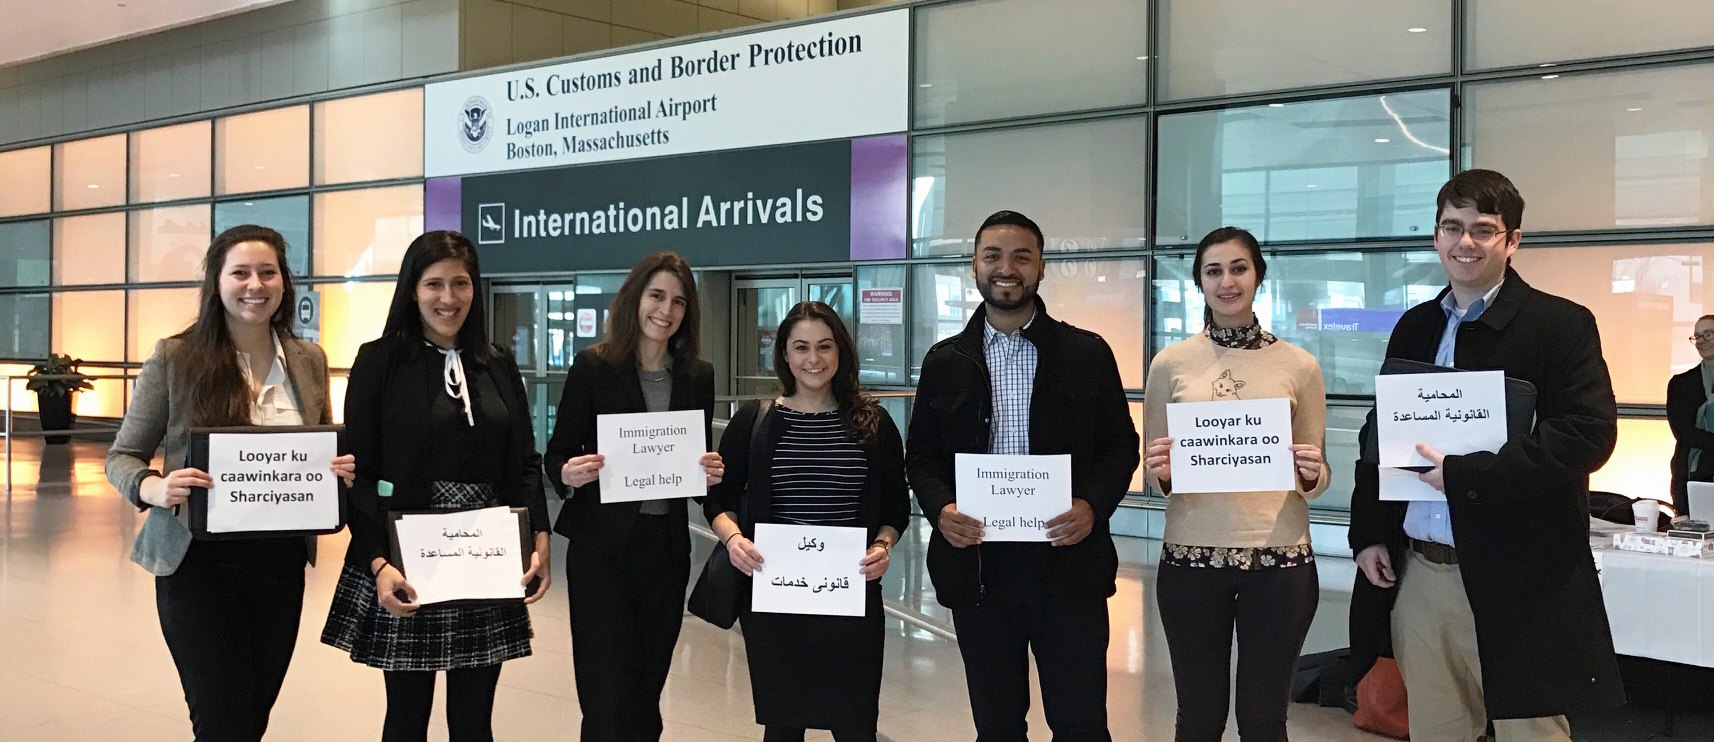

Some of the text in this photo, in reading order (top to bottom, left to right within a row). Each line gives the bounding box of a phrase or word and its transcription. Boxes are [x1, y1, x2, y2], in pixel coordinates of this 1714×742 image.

[506, 31, 862, 102] U.S. Customs and Border Protection
[506, 93, 718, 139] Logan International Airport
[506, 127, 670, 161] Boston, Massachusetts
[514, 188, 824, 238] International Arrivals
[1417, 387, 1463, 403] المحامية
[1195, 413, 1262, 429] Looyar ku
[1392, 407, 1490, 423] القانونية المساعدة
[619, 424, 687, 440] Immigration
[1180, 434, 1280, 447] caawinkara oo
[238, 448, 308, 465] Looyar ku
[632, 443, 675, 455] Lawyer
[1190, 453, 1271, 467] Sharciyasan
[219, 469, 324, 483] caawinkara oo
[624, 472, 683, 489] Legal help
[976, 467, 1050, 482] Immigration
[229, 489, 315, 505] Sharciyasan
[990, 484, 1036, 499] Lawyer
[983, 516, 1045, 531] Legal help
[442, 527, 482, 540] المحامية
[797, 535, 826, 552] وكيل
[770, 575, 809, 588] خدمات
